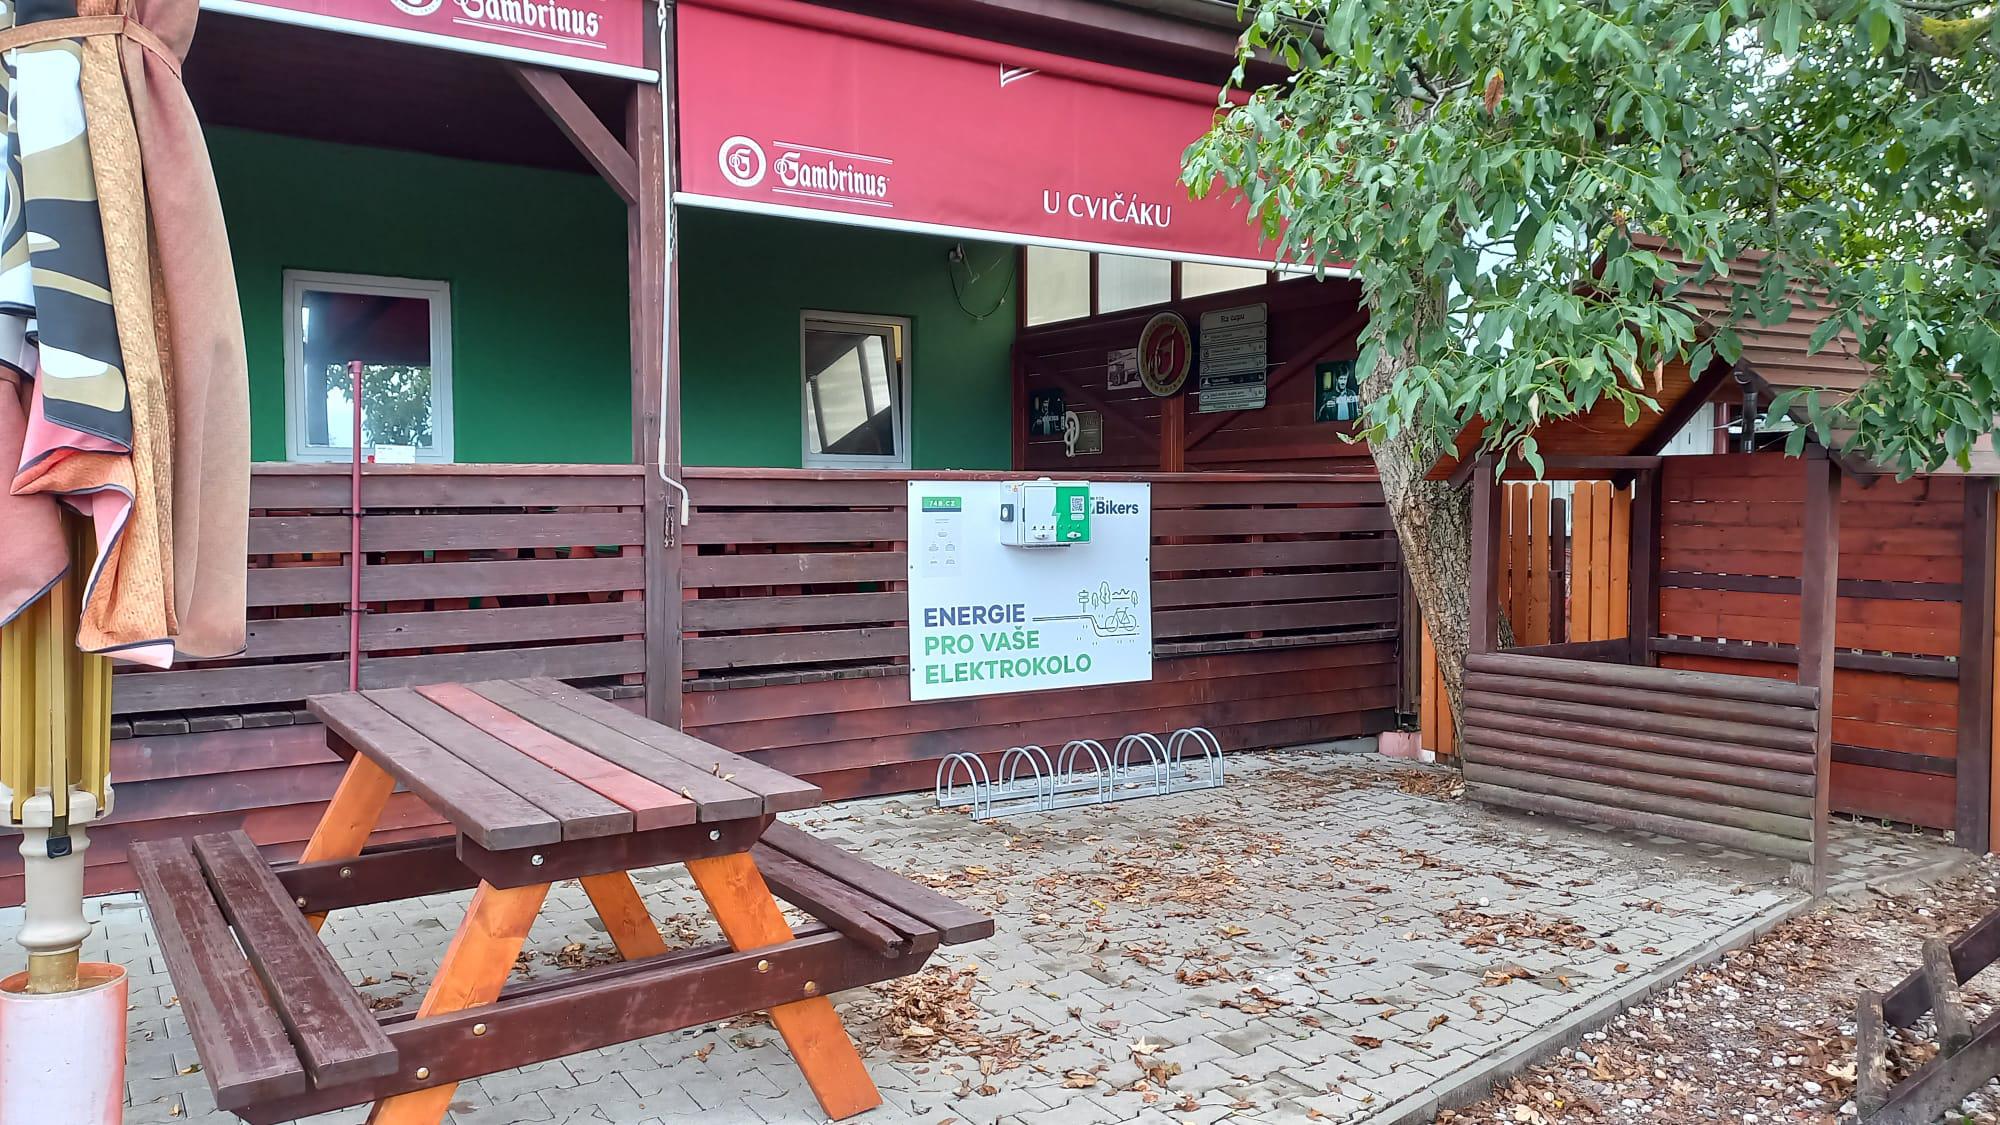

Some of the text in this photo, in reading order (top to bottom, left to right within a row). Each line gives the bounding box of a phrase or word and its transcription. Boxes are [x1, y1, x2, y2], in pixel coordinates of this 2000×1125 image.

[774, 151, 889, 198] Gambrinus
[1043, 190, 1171, 227] U CVIČÁKU
[924, 604, 1025, 627] ENERGIE
[925, 626, 1040, 656] PRO VAŠE
[925, 654, 1092, 684] ELEKTROKOLO
